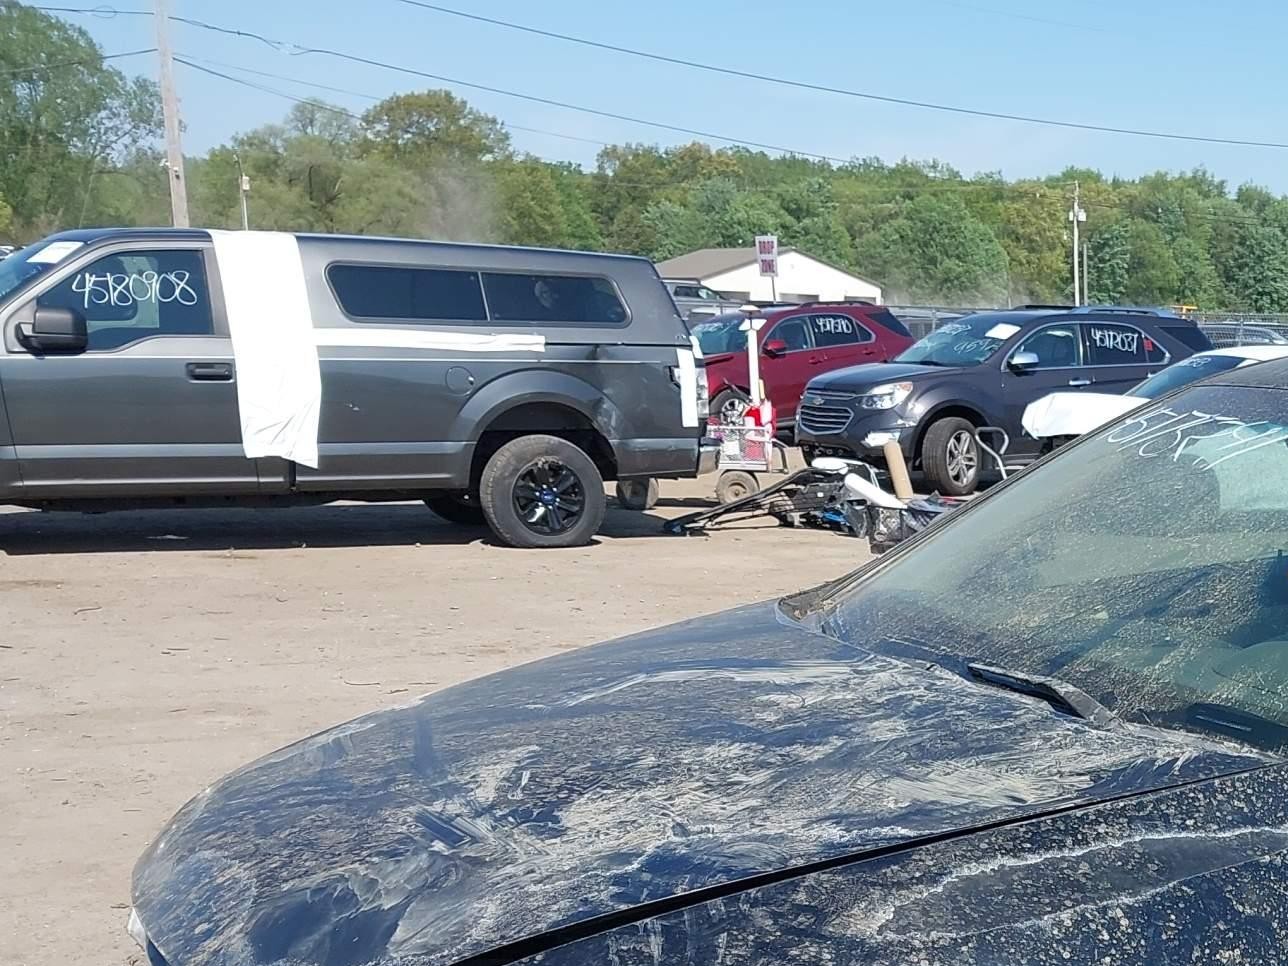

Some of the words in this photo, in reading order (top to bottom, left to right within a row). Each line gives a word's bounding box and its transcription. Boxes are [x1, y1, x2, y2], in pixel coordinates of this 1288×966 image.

[758, 241, 775, 255] DROP
[760, 259, 776, 273] ZONE
[72, 270, 198, 308] 45180908
